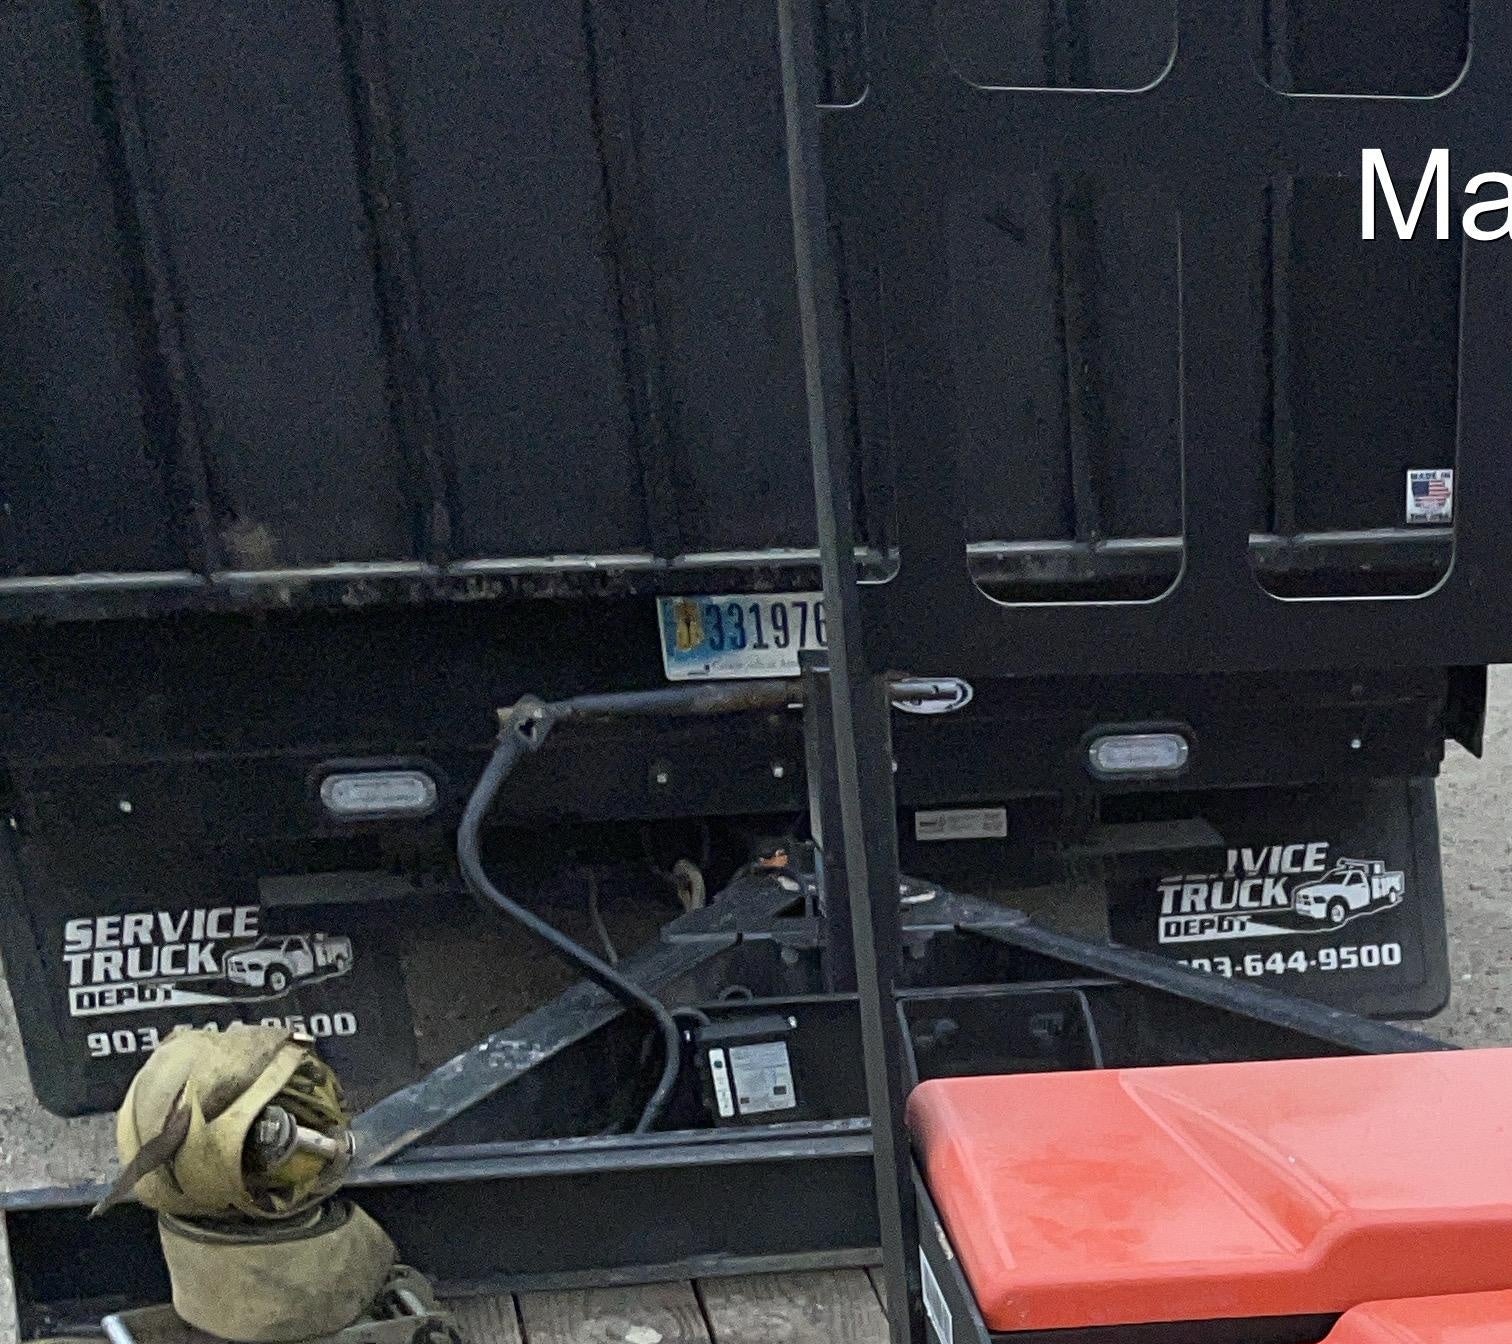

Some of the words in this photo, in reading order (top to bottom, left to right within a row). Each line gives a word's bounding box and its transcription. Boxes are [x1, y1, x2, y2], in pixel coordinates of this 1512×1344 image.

[1157, 876, 1290, 914] TRUCK
[64, 906, 262, 952] SERVICE
[1164, 915, 1253, 937] DEPOT
[63, 942, 221, 985] TRUCK
[1176, 942, 1402, 978] 03-644-9500
[76, 984, 176, 1011] DEPOT
